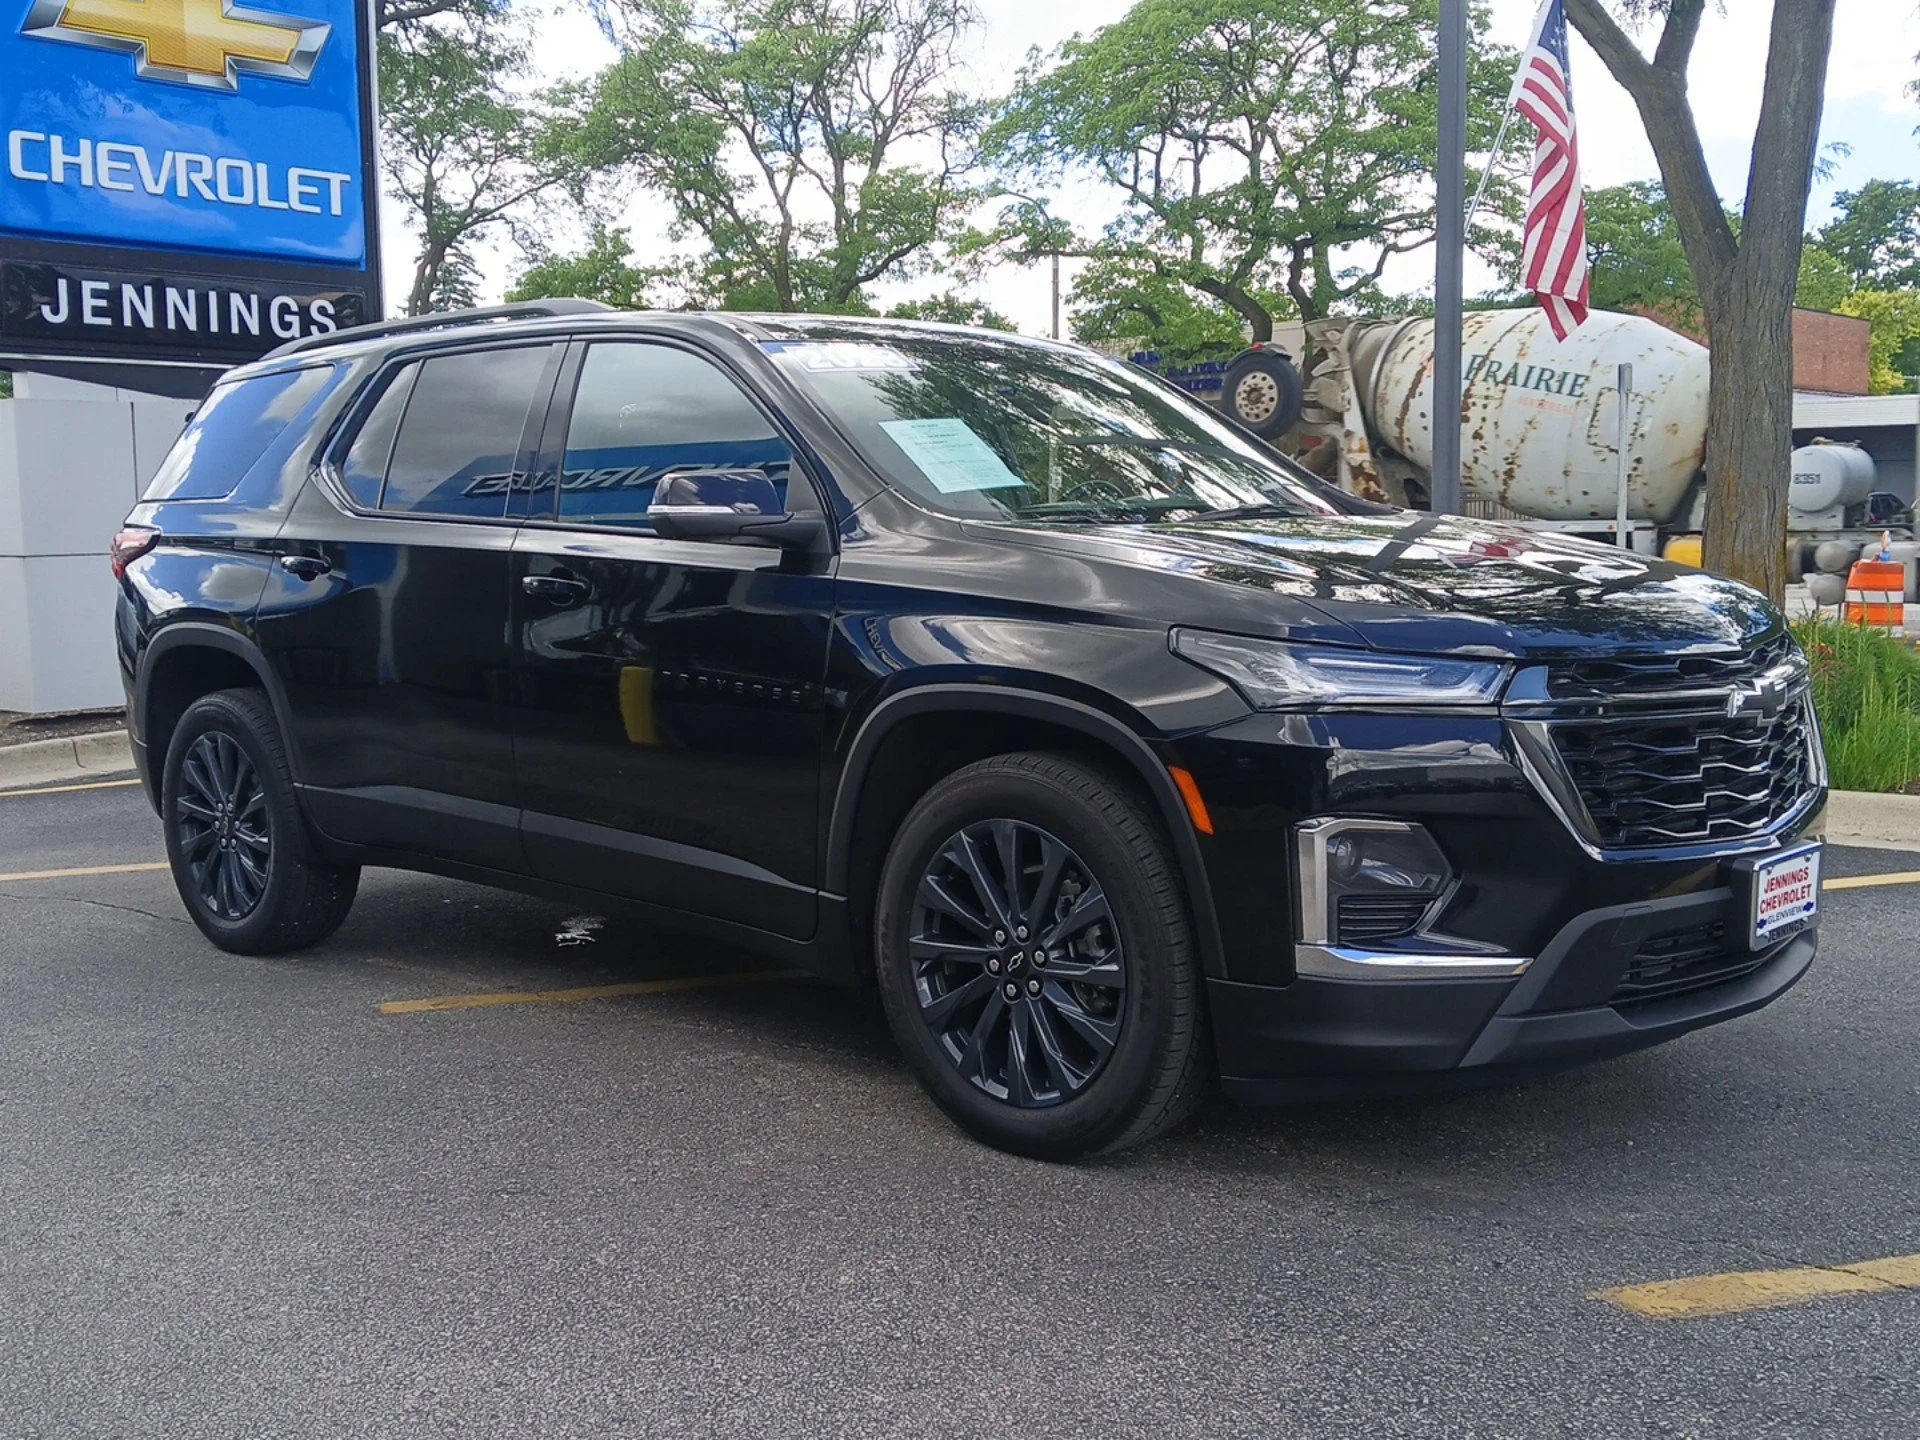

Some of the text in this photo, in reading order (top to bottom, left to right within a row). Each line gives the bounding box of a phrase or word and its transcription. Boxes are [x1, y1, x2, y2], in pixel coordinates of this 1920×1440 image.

[9, 130, 351, 216] CHEVROLET
[41, 278, 336, 338] JENNINGS
[1463, 354, 1590, 398] PRAIRIE
[1760, 884, 1812, 914] CHEVROLET
[1764, 867, 1809, 893] JENNINGS
